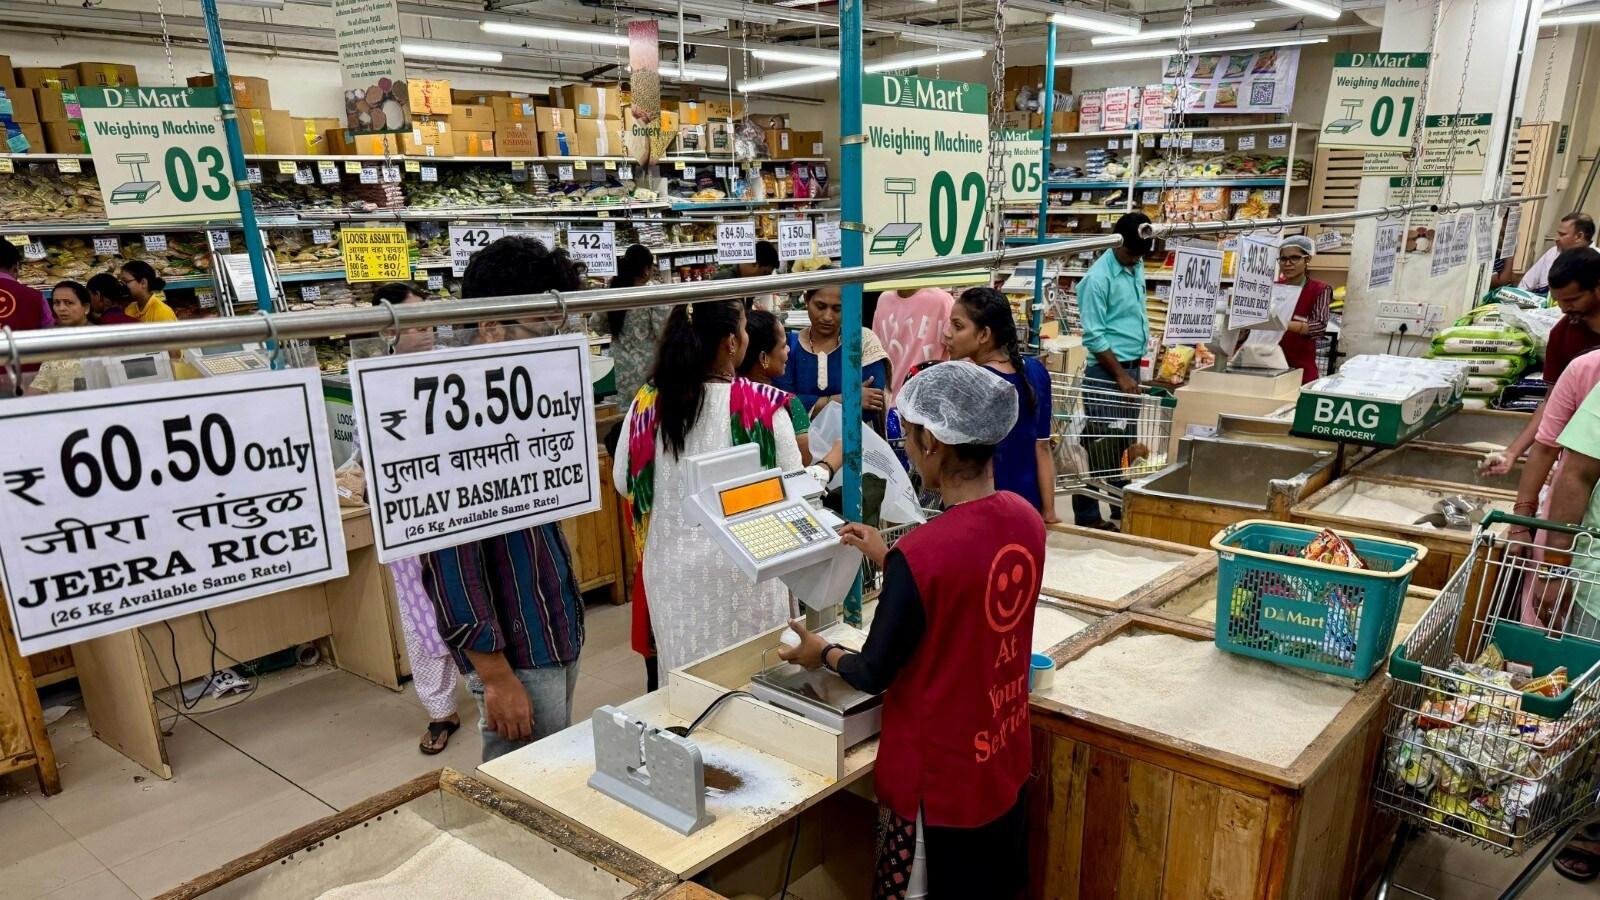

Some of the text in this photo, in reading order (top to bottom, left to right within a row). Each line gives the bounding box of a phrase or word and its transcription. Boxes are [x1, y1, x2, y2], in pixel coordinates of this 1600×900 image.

[1336, 76, 1420, 89] Weighing Machine
[94, 120, 215, 139] Weighing Machine
[632, 124, 661, 140] Grocery
[1370, 96, 1415, 137] 01
[869, 126, 982, 157] Weighing Machine
[1013, 148, 1039, 156] Machine
[165, 146, 231, 203] 03
[1012, 162, 1040, 193] 05
[929, 170, 986, 256] 02
[346, 233, 405, 244] LOOSE ASSAM TEA
[462, 230, 490, 247] 42
[578, 234, 601, 250] 42
[725, 226, 745, 239] 84.50
[788, 226, 803, 239] 150
[355, 254, 365, 262] Kg
[720, 249, 754, 258] MASOOR DAL
[781, 250, 797, 258] UDID
[1247, 243, 1269, 277] 90.50
[1185, 257, 1211, 291] 60.50
[1234, 295, 1269, 310] BIRYANI RICE
[1169, 313, 1213, 325] HMT KOLAM RICE
[379, 365, 581, 441] ₹ 73.50 Only
[1314, 397, 1380, 429] BAG
[337, 413, 354, 426] LOOS
[1312, 424, 1376, 441] FOR GROCERY
[3, 413, 311, 506] ₹ 60.50 Only
[381, 427, 575, 494] पुलाव बासमती तांदुळ
[383, 462, 584, 525] PULAV BASMATI RICE
[21, 487, 307, 555] जीरा तांदुळ
[405, 493, 560, 540] (26 Kg Available Same Rate)
[18, 523, 318, 609] JEERA RICE
[51, 560, 292, 628] (26 Kg Available Same Rate)
[994, 634, 1018, 669] At
[988, 673, 1025, 718] Your
